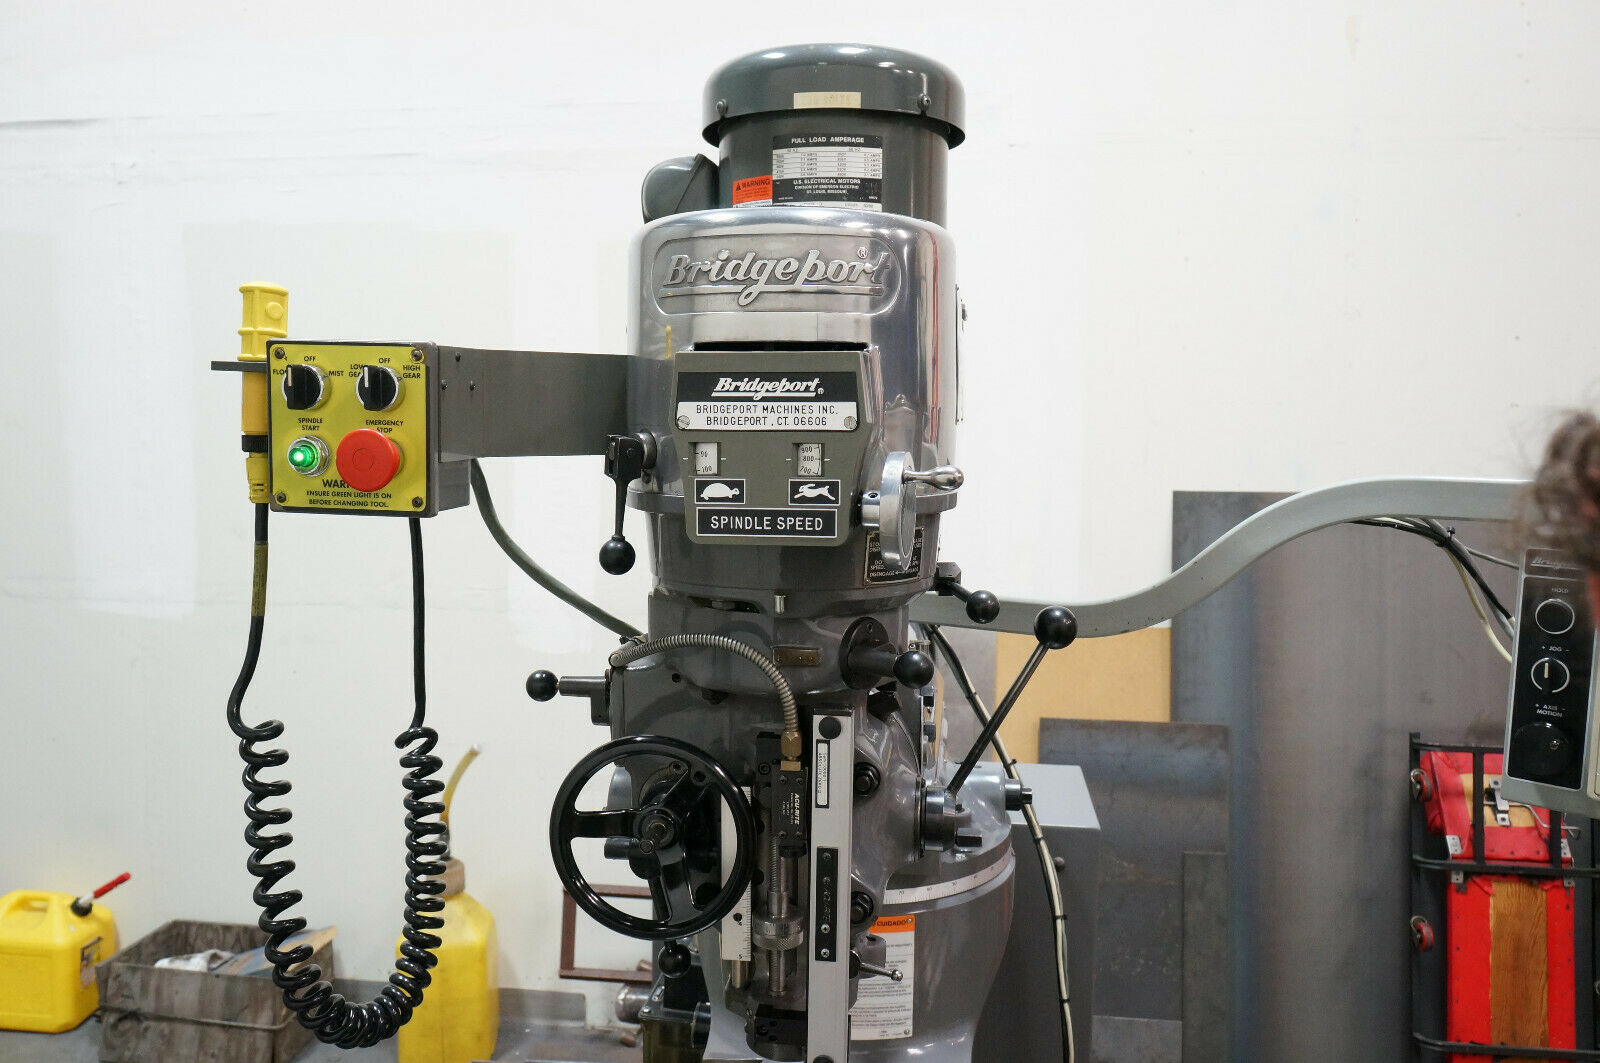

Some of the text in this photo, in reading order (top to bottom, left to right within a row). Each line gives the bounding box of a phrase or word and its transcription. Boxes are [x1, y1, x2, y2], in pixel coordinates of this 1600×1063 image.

[741, 178, 771, 189] WARNING
[662, 249, 891, 306] Bridgeport
[712, 377, 821, 400] Bridgeport
[696, 404, 839, 415] BRIDGEPORT MACHINES INC.
[365, 419, 404, 427] EMERGENCY
[776, 417, 790, 426] CT.
[793, 417, 828, 426] 06606
[353, 491, 373, 499] LIGHT
[333, 499, 369, 507] CHANGING
[710, 515, 823, 531] SPINDLE SPEED
[1536, 709, 1563, 718] MOTION
